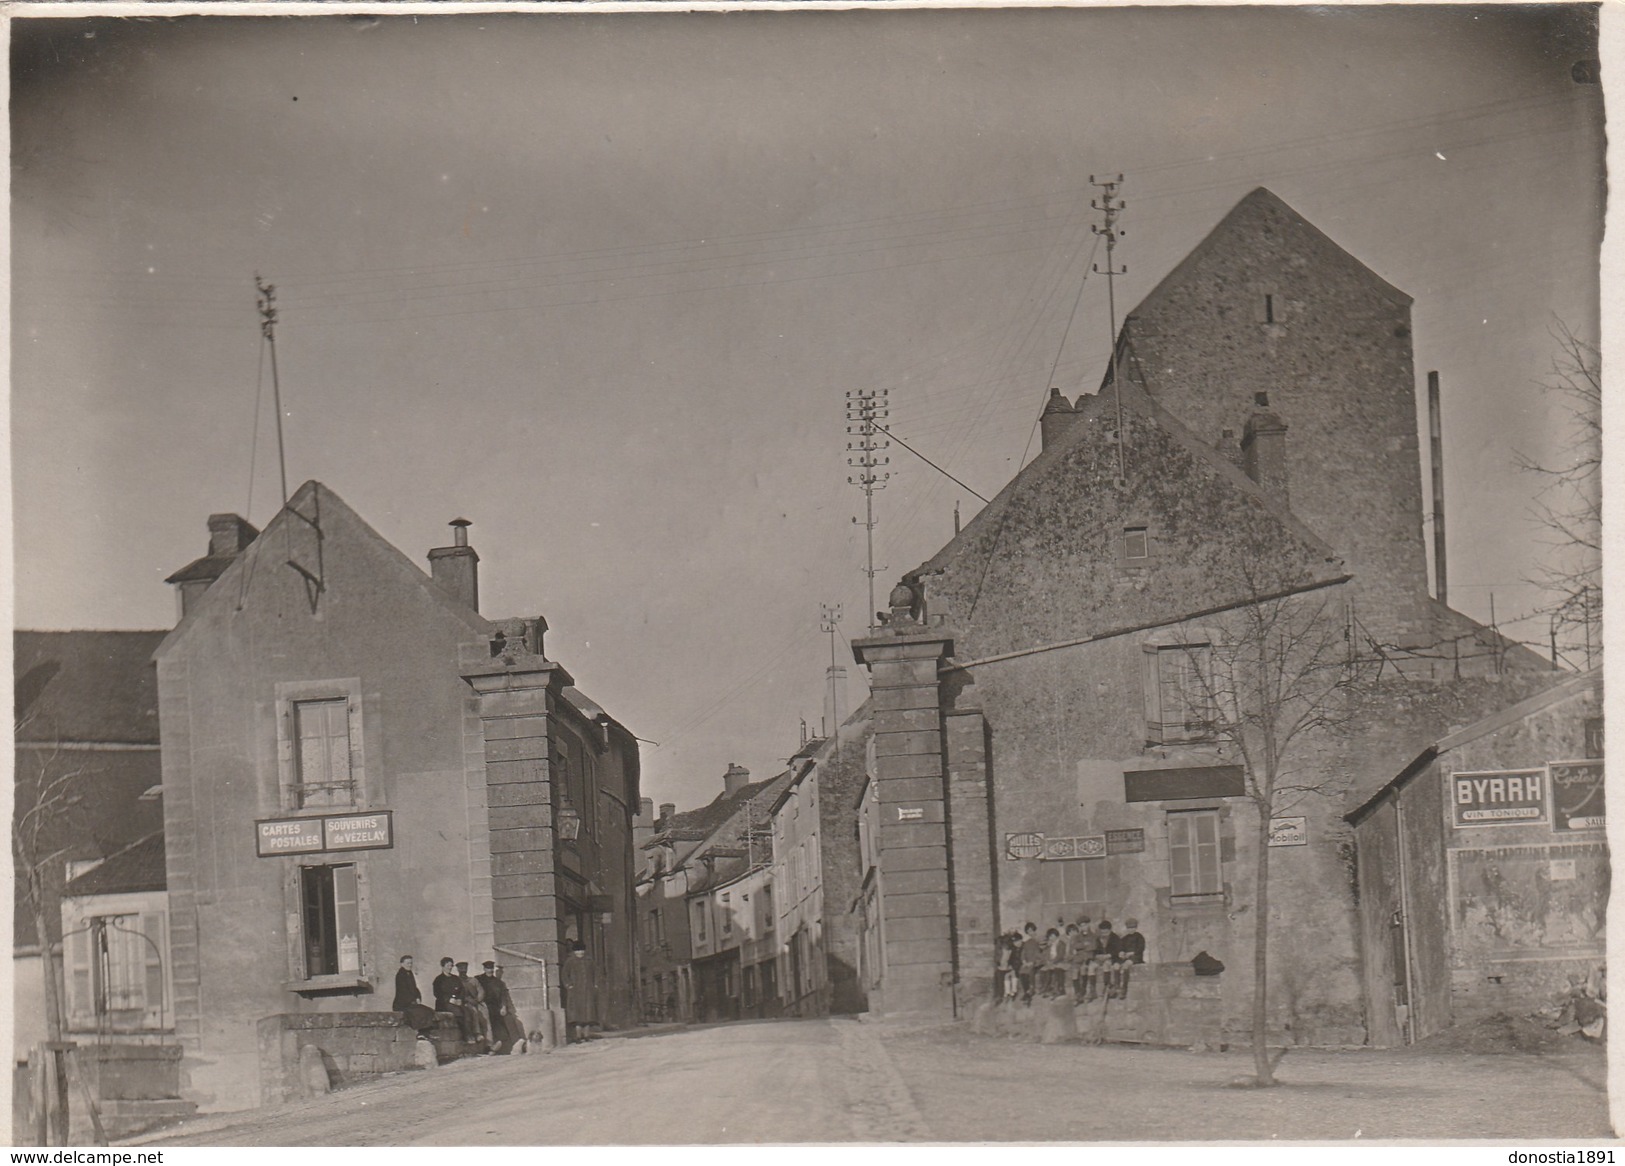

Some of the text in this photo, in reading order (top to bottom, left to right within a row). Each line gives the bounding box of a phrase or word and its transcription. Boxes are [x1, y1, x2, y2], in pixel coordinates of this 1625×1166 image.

[1458, 776, 1541, 804] BYRRH
[1466, 808, 1536, 819] VIN TONIQUE
[262, 824, 301, 836] CARTES
[328, 818, 378, 831] SOUVENIRS
[270, 835, 319, 848] POSTALES
[334, 834, 344, 844] de
[1268, 832, 1304, 842] Mobiloil
